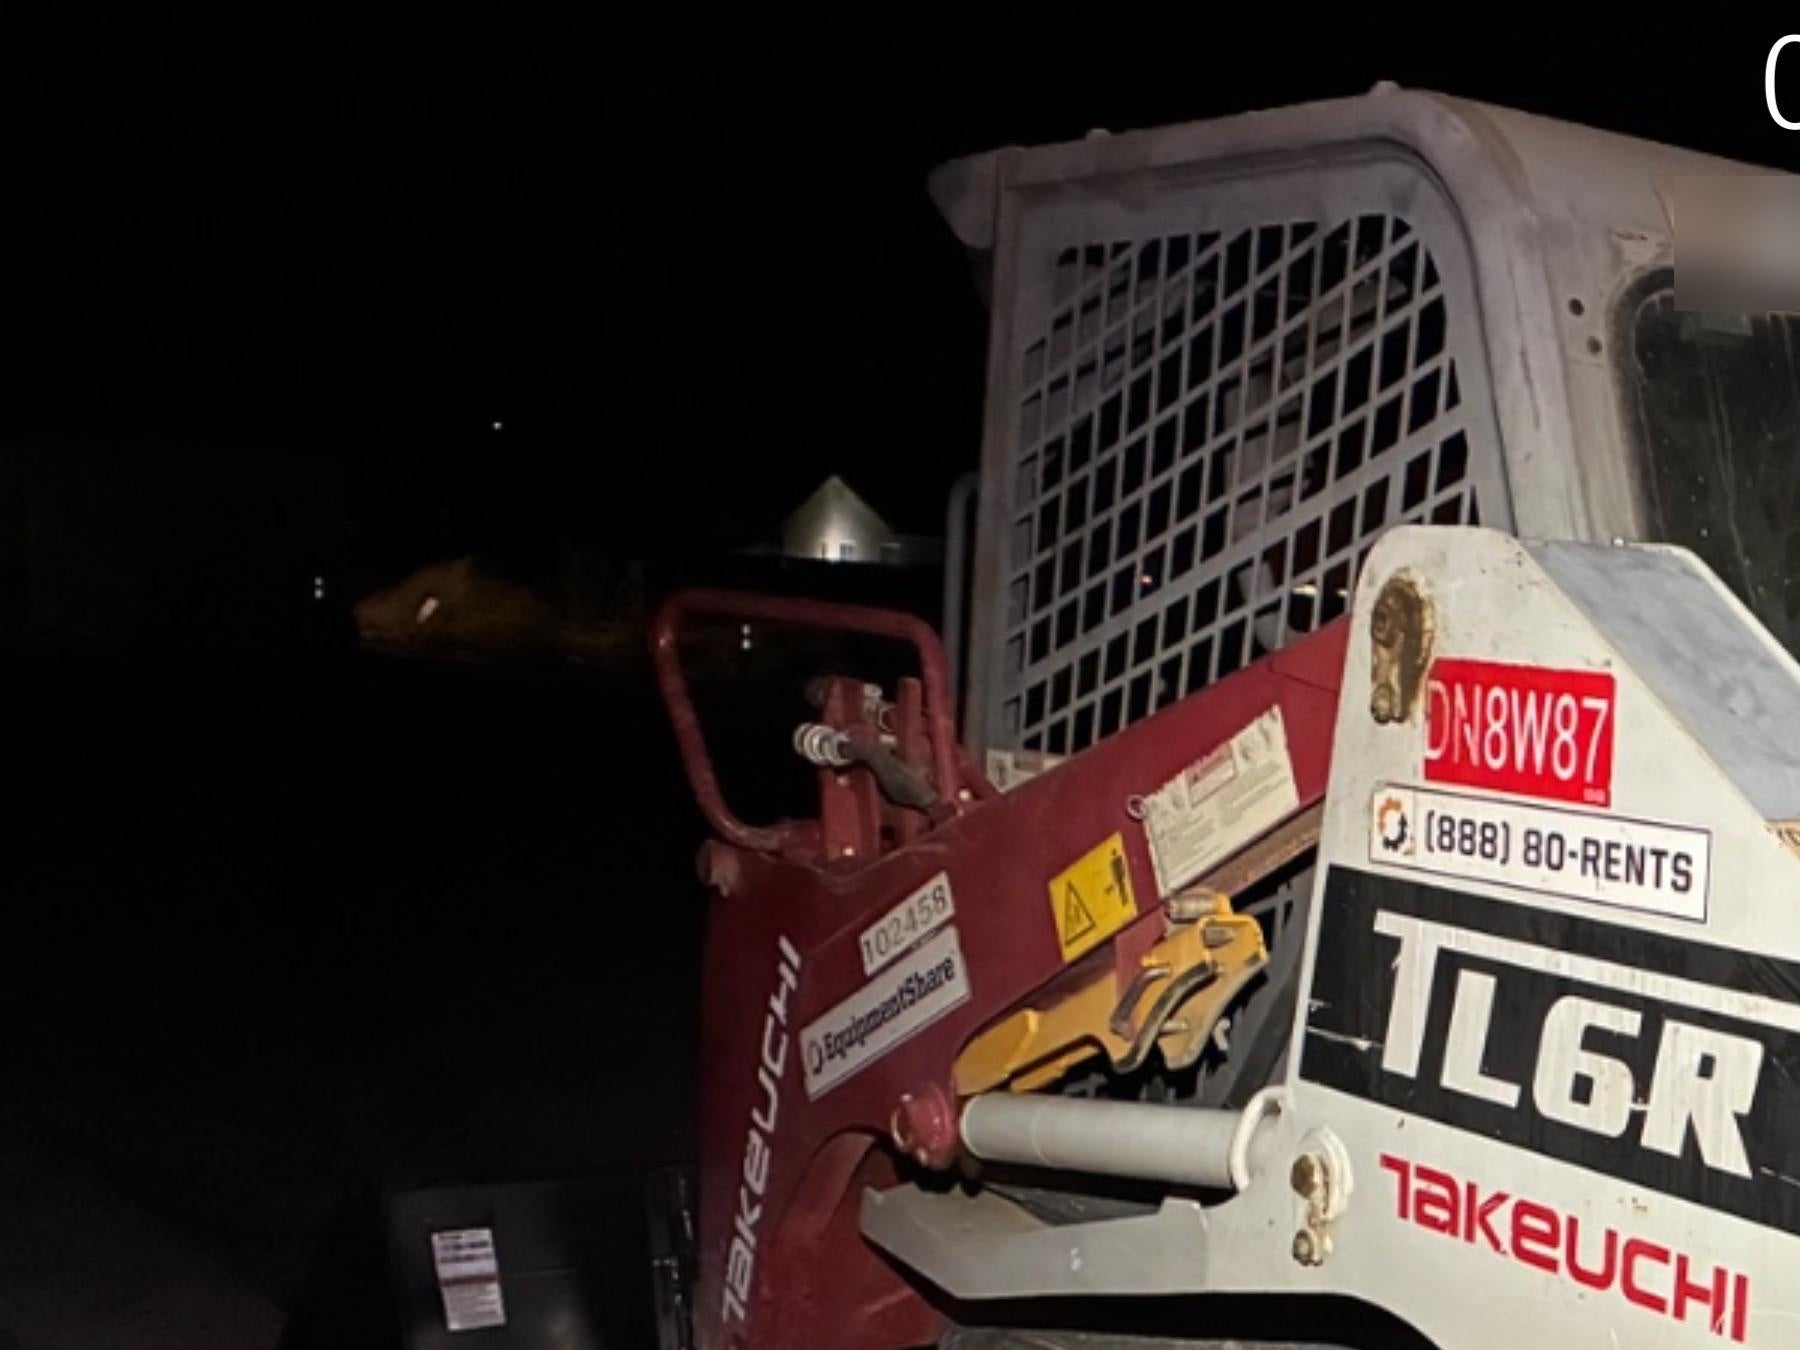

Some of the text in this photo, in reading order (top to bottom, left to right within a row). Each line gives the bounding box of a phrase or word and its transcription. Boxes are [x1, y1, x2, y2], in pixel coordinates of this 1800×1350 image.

[1425, 680, 1609, 784] DN8W87
[1425, 810, 1694, 893] (888) 80-RENTS
[862, 884, 949, 964] 102458
[822, 956, 955, 1060] EquipmentShare
